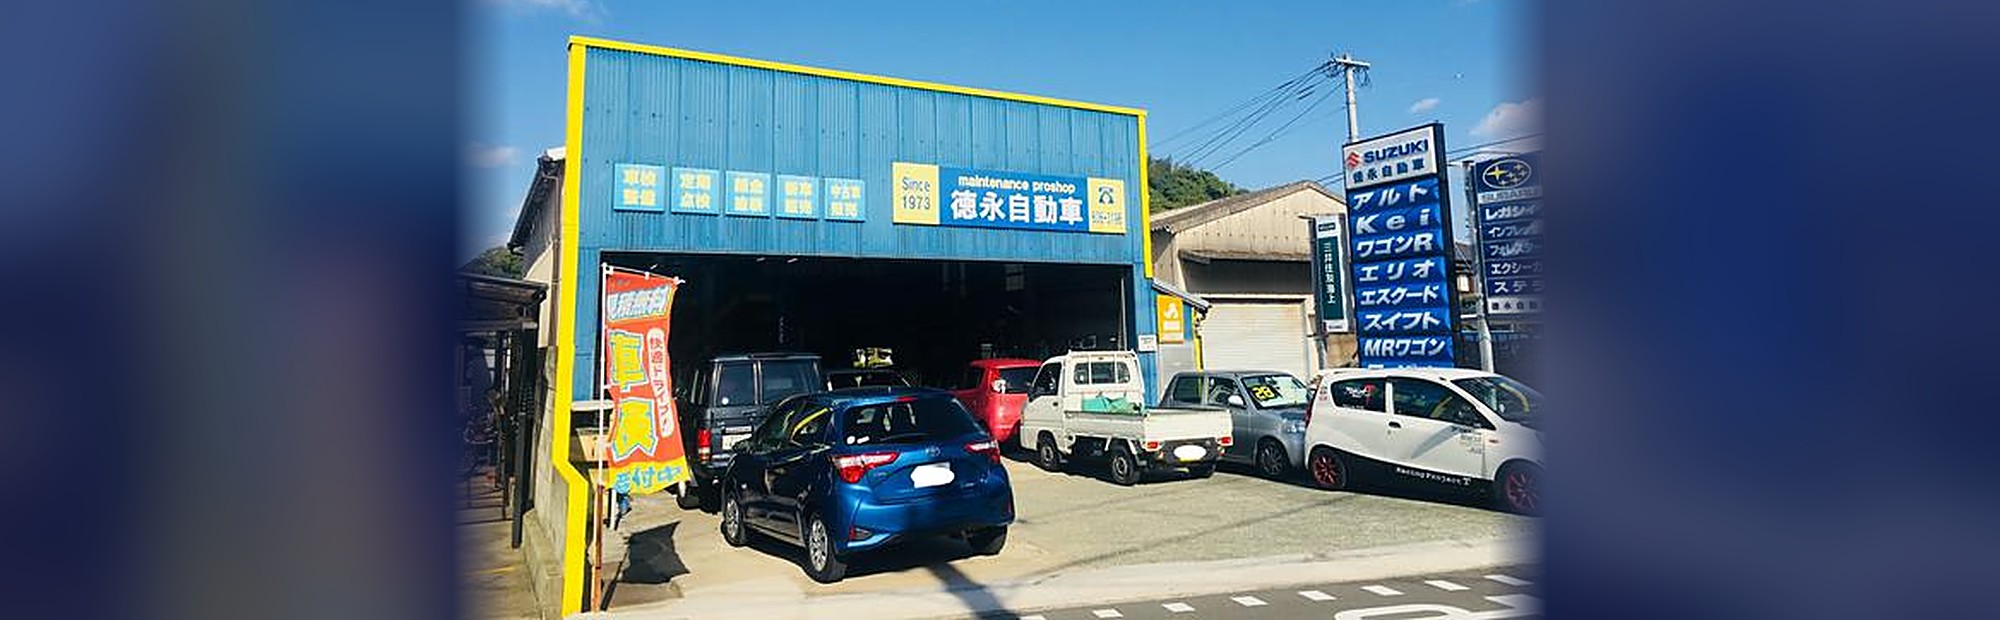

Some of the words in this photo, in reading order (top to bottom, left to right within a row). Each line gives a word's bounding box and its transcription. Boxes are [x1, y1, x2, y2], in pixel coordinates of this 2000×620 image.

[1363, 138, 1429, 164] SUZUKI
[1352, 157, 1425, 183] 徳永自動車
[901, 176, 931, 193] Since
[957, 175, 1029, 191] maintenance
[1032, 181, 1076, 195] proshop
[901, 196, 931, 211] 1973
[951, 189, 1084, 225] 徳永自動車
[1353, 184, 1428, 211] アルト
[1356, 208, 1431, 235] Kei
[1356, 233, 1433, 258] ワゴンR
[1359, 259, 1435, 282] エリオ
[1360, 285, 1440, 306] エスクード
[1363, 311, 1441, 331] スイフト
[1364, 338, 1446, 357] MRワゴン
